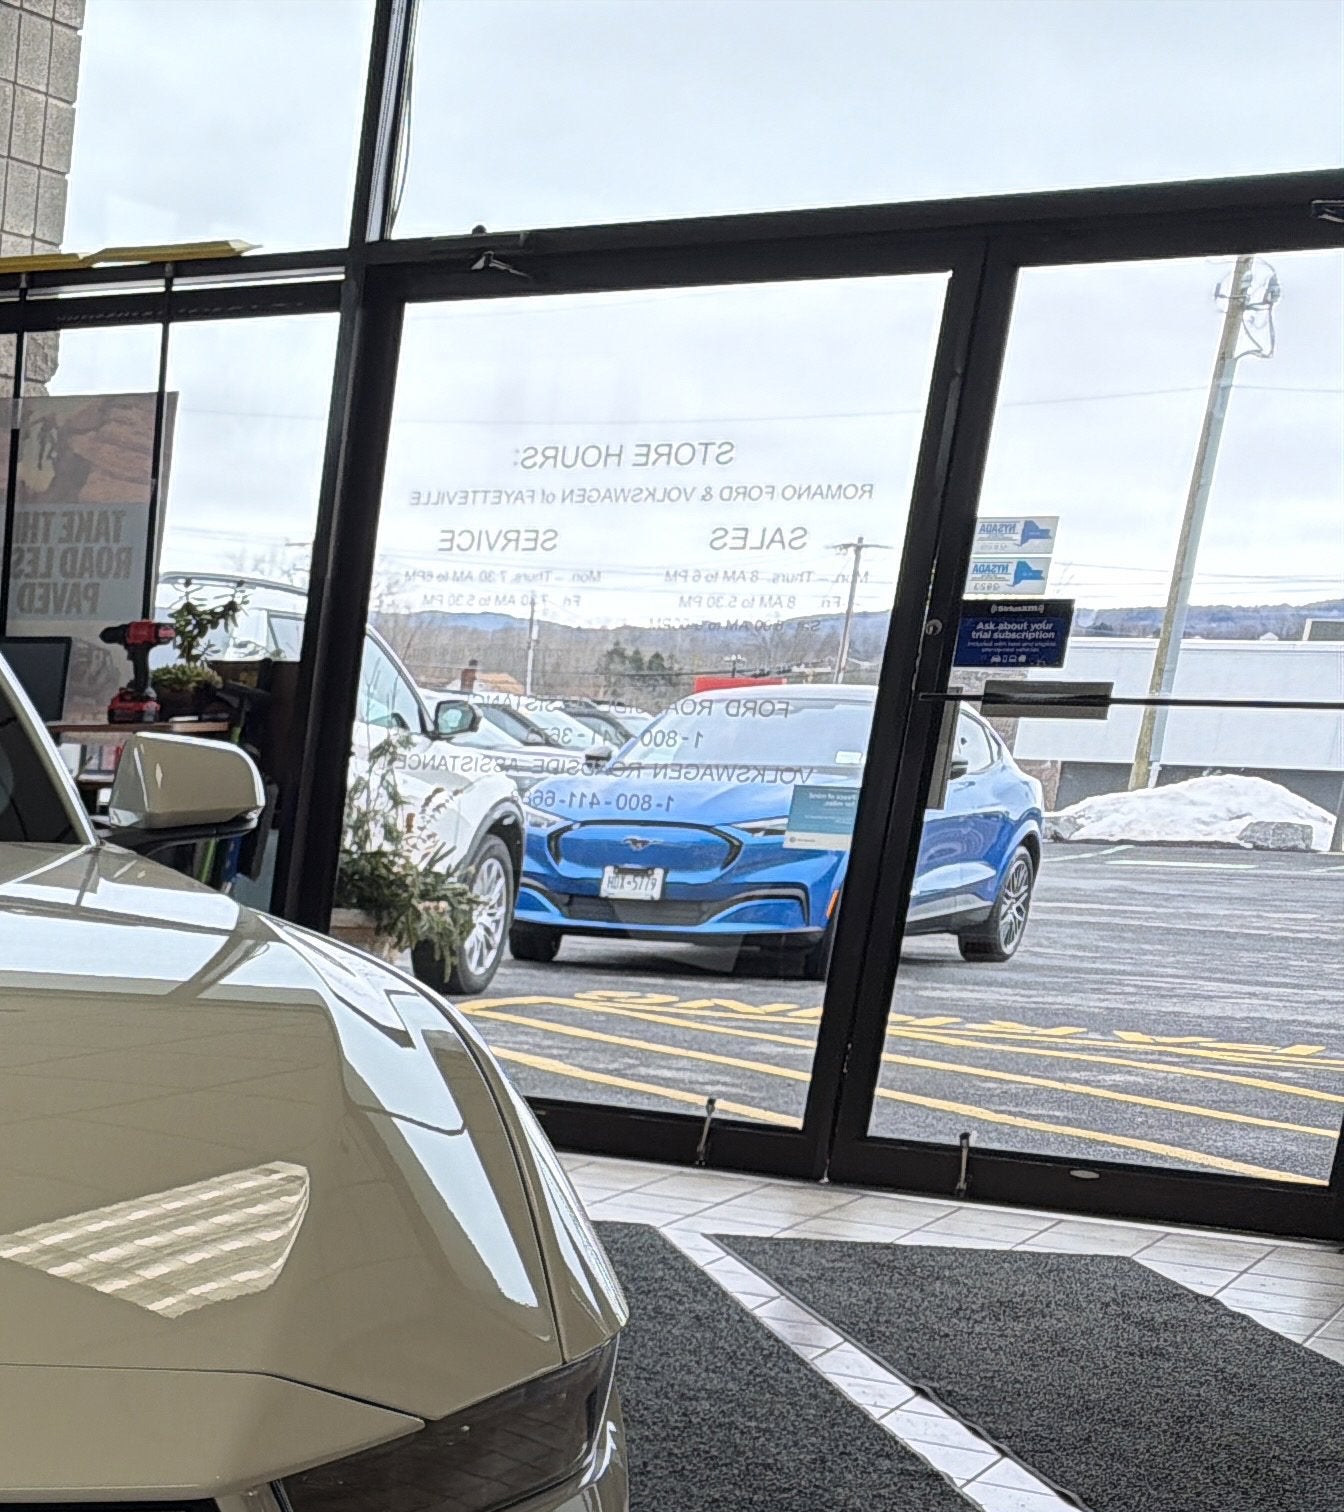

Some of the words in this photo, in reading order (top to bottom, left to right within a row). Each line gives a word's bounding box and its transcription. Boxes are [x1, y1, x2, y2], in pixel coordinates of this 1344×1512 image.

[976, 621, 996, 630] Ask
[997, 621, 1027, 630] about
[1030, 621, 1054, 632] your
[971, 630, 992, 639] trial
[992, 630, 1056, 640] subscription
